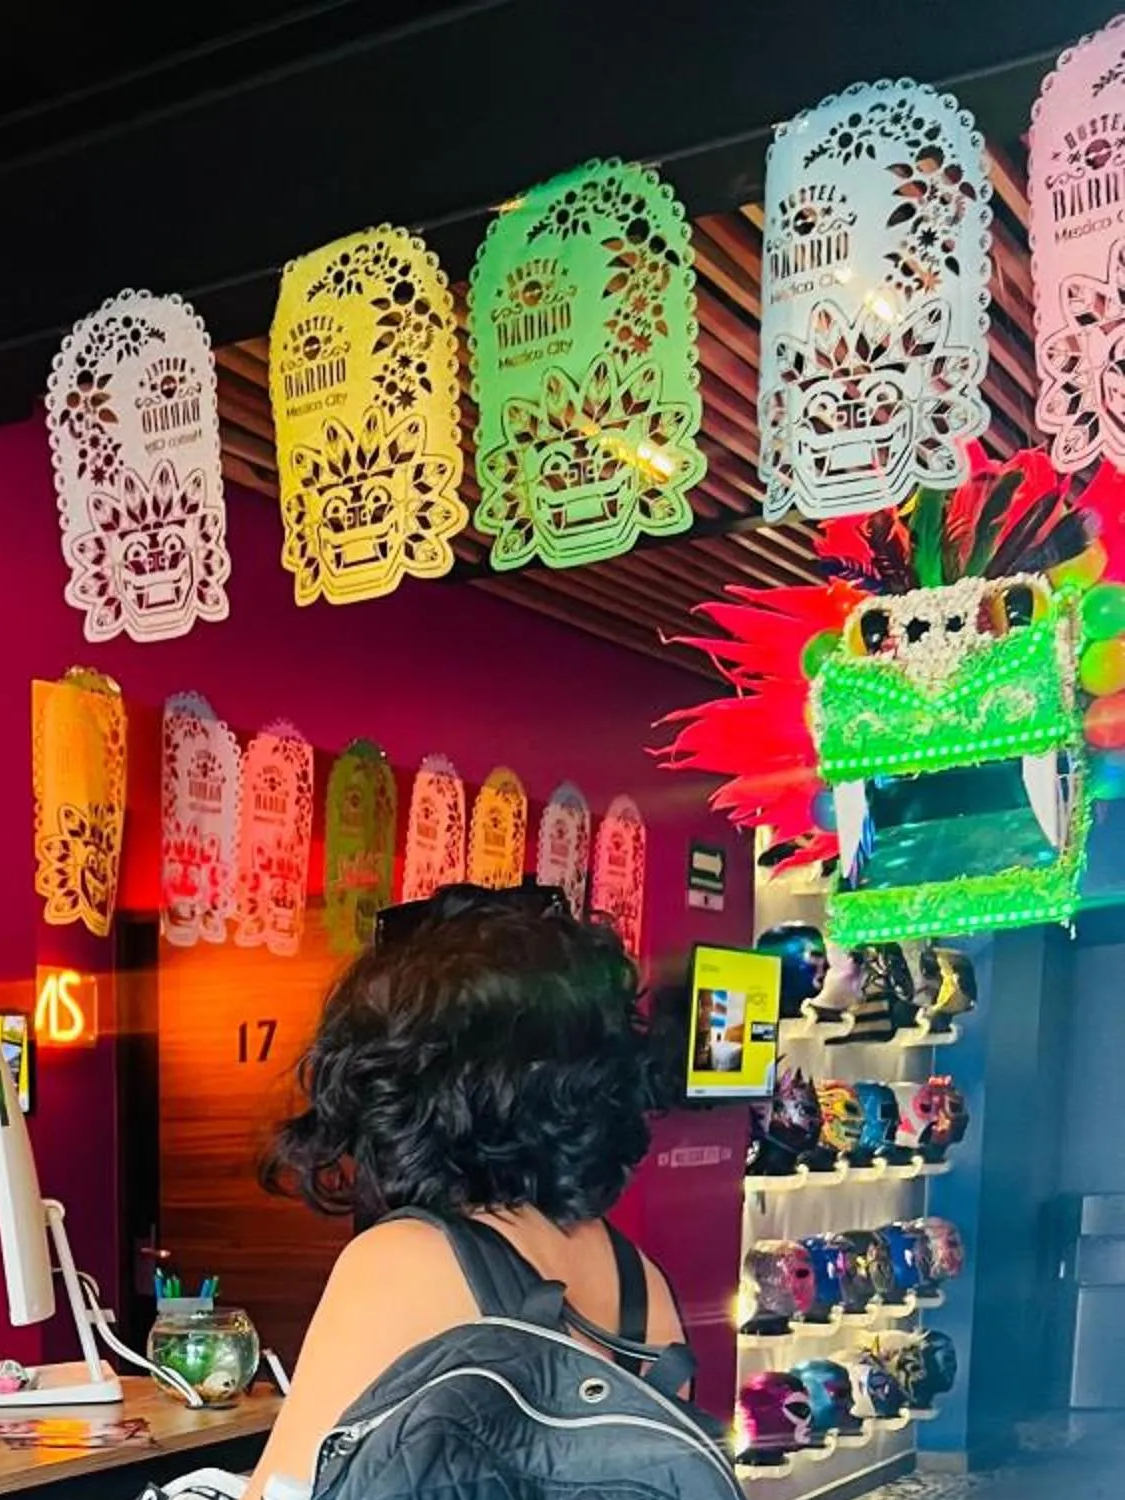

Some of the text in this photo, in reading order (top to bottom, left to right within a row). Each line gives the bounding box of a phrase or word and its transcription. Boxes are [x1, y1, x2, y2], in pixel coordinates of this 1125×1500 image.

[1063, 112, 1125, 150] HOSTE
[1052, 170, 1125, 223] BARR
[238, 1019, 278, 1063] 17
